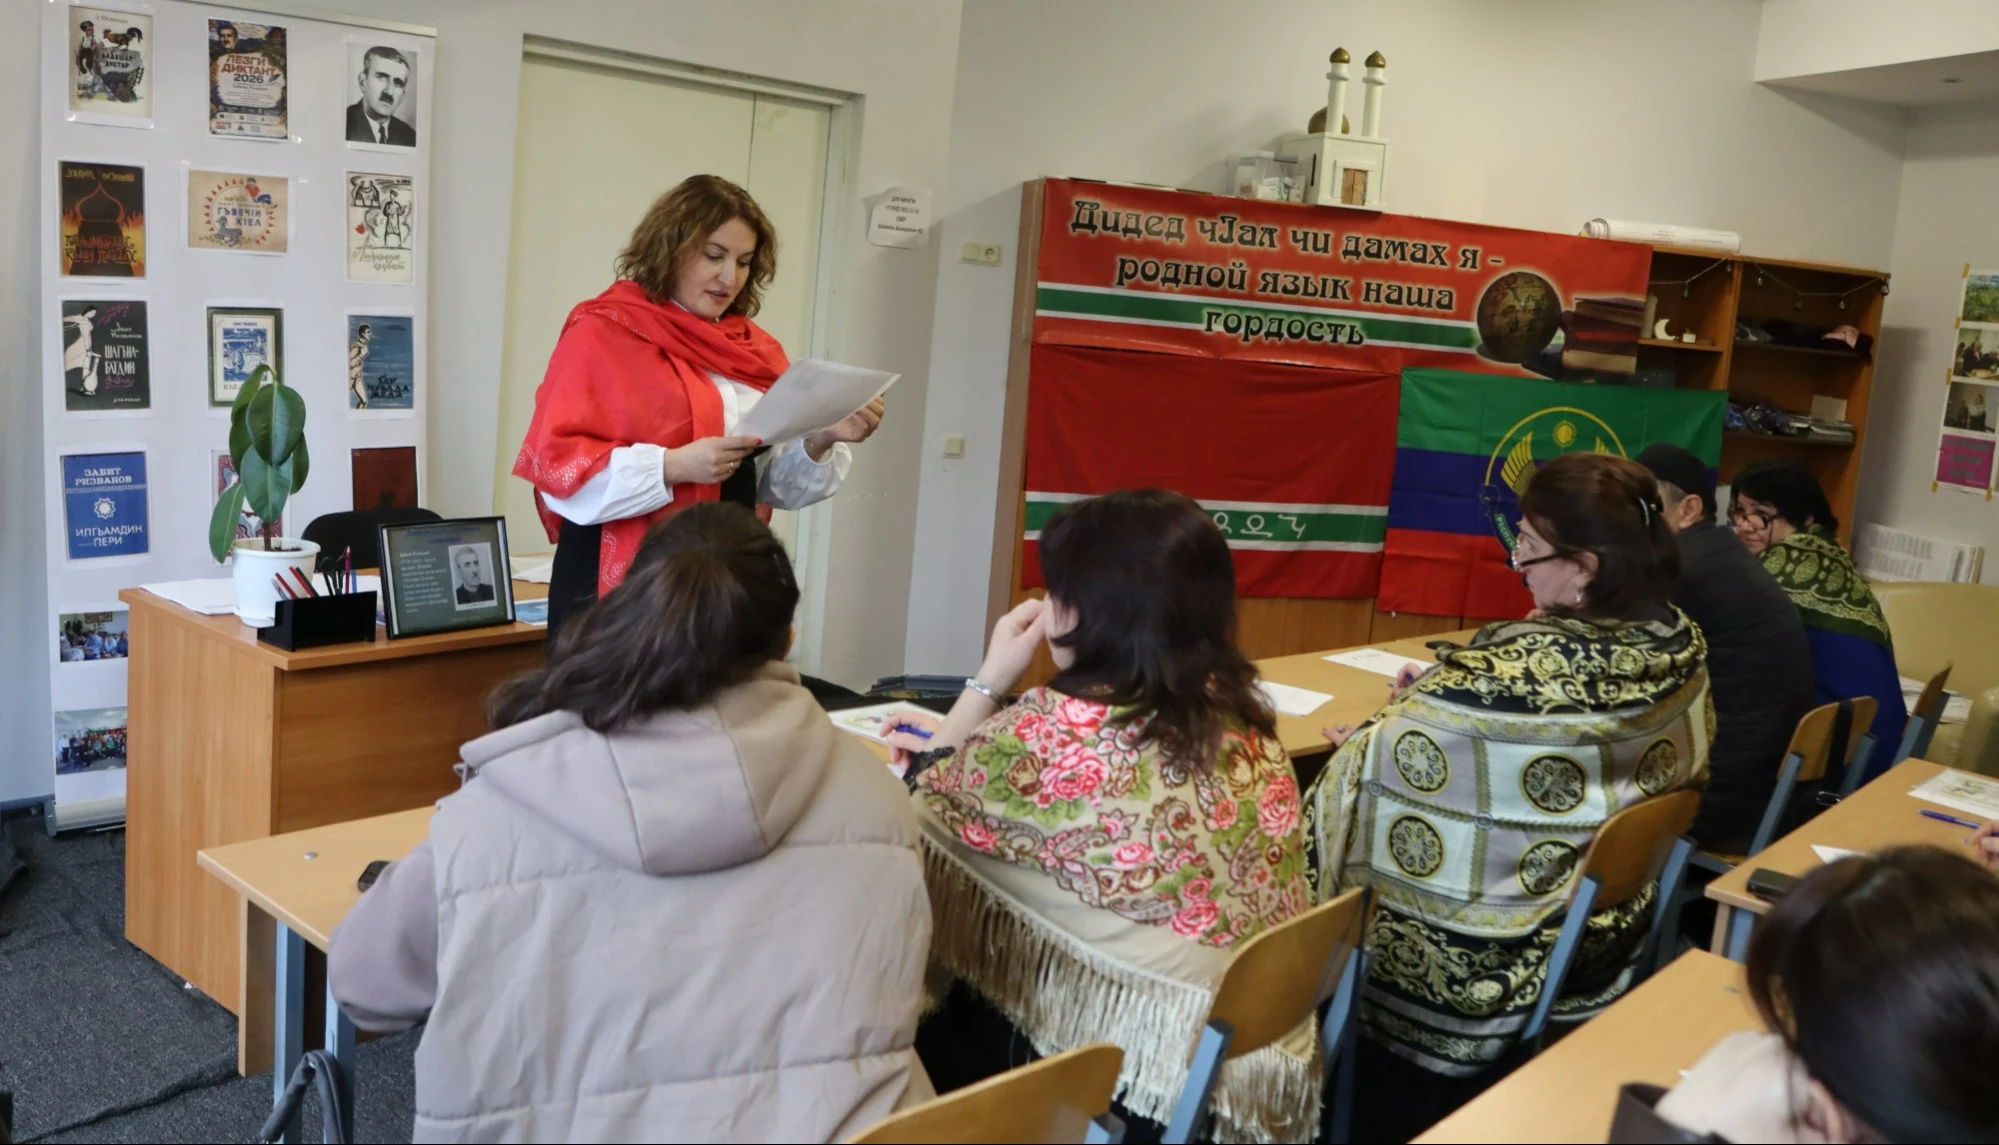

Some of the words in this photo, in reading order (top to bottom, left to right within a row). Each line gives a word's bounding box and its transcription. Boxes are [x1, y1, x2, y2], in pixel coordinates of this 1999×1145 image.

[226, 54, 266, 67] ЛЕЗГИ
[221, 63, 276, 76] ДИКТАНТ
[234, 73, 264, 84] 2026
[1071, 200, 1186, 243] Дидед
[1290, 229, 1332, 254] чи
[1341, 235, 1448, 267] дамах
[1115, 257, 1248, 291] родной
[1257, 272, 1351, 301] язык
[1362, 281, 1454, 311] наша
[1204, 311, 1365, 345] гордость
[84, 467, 121, 477] ЗАБИТ
[75, 476, 133, 487] РИЗВАНОВ
[93, 536, 123, 548] ПЕРИ
